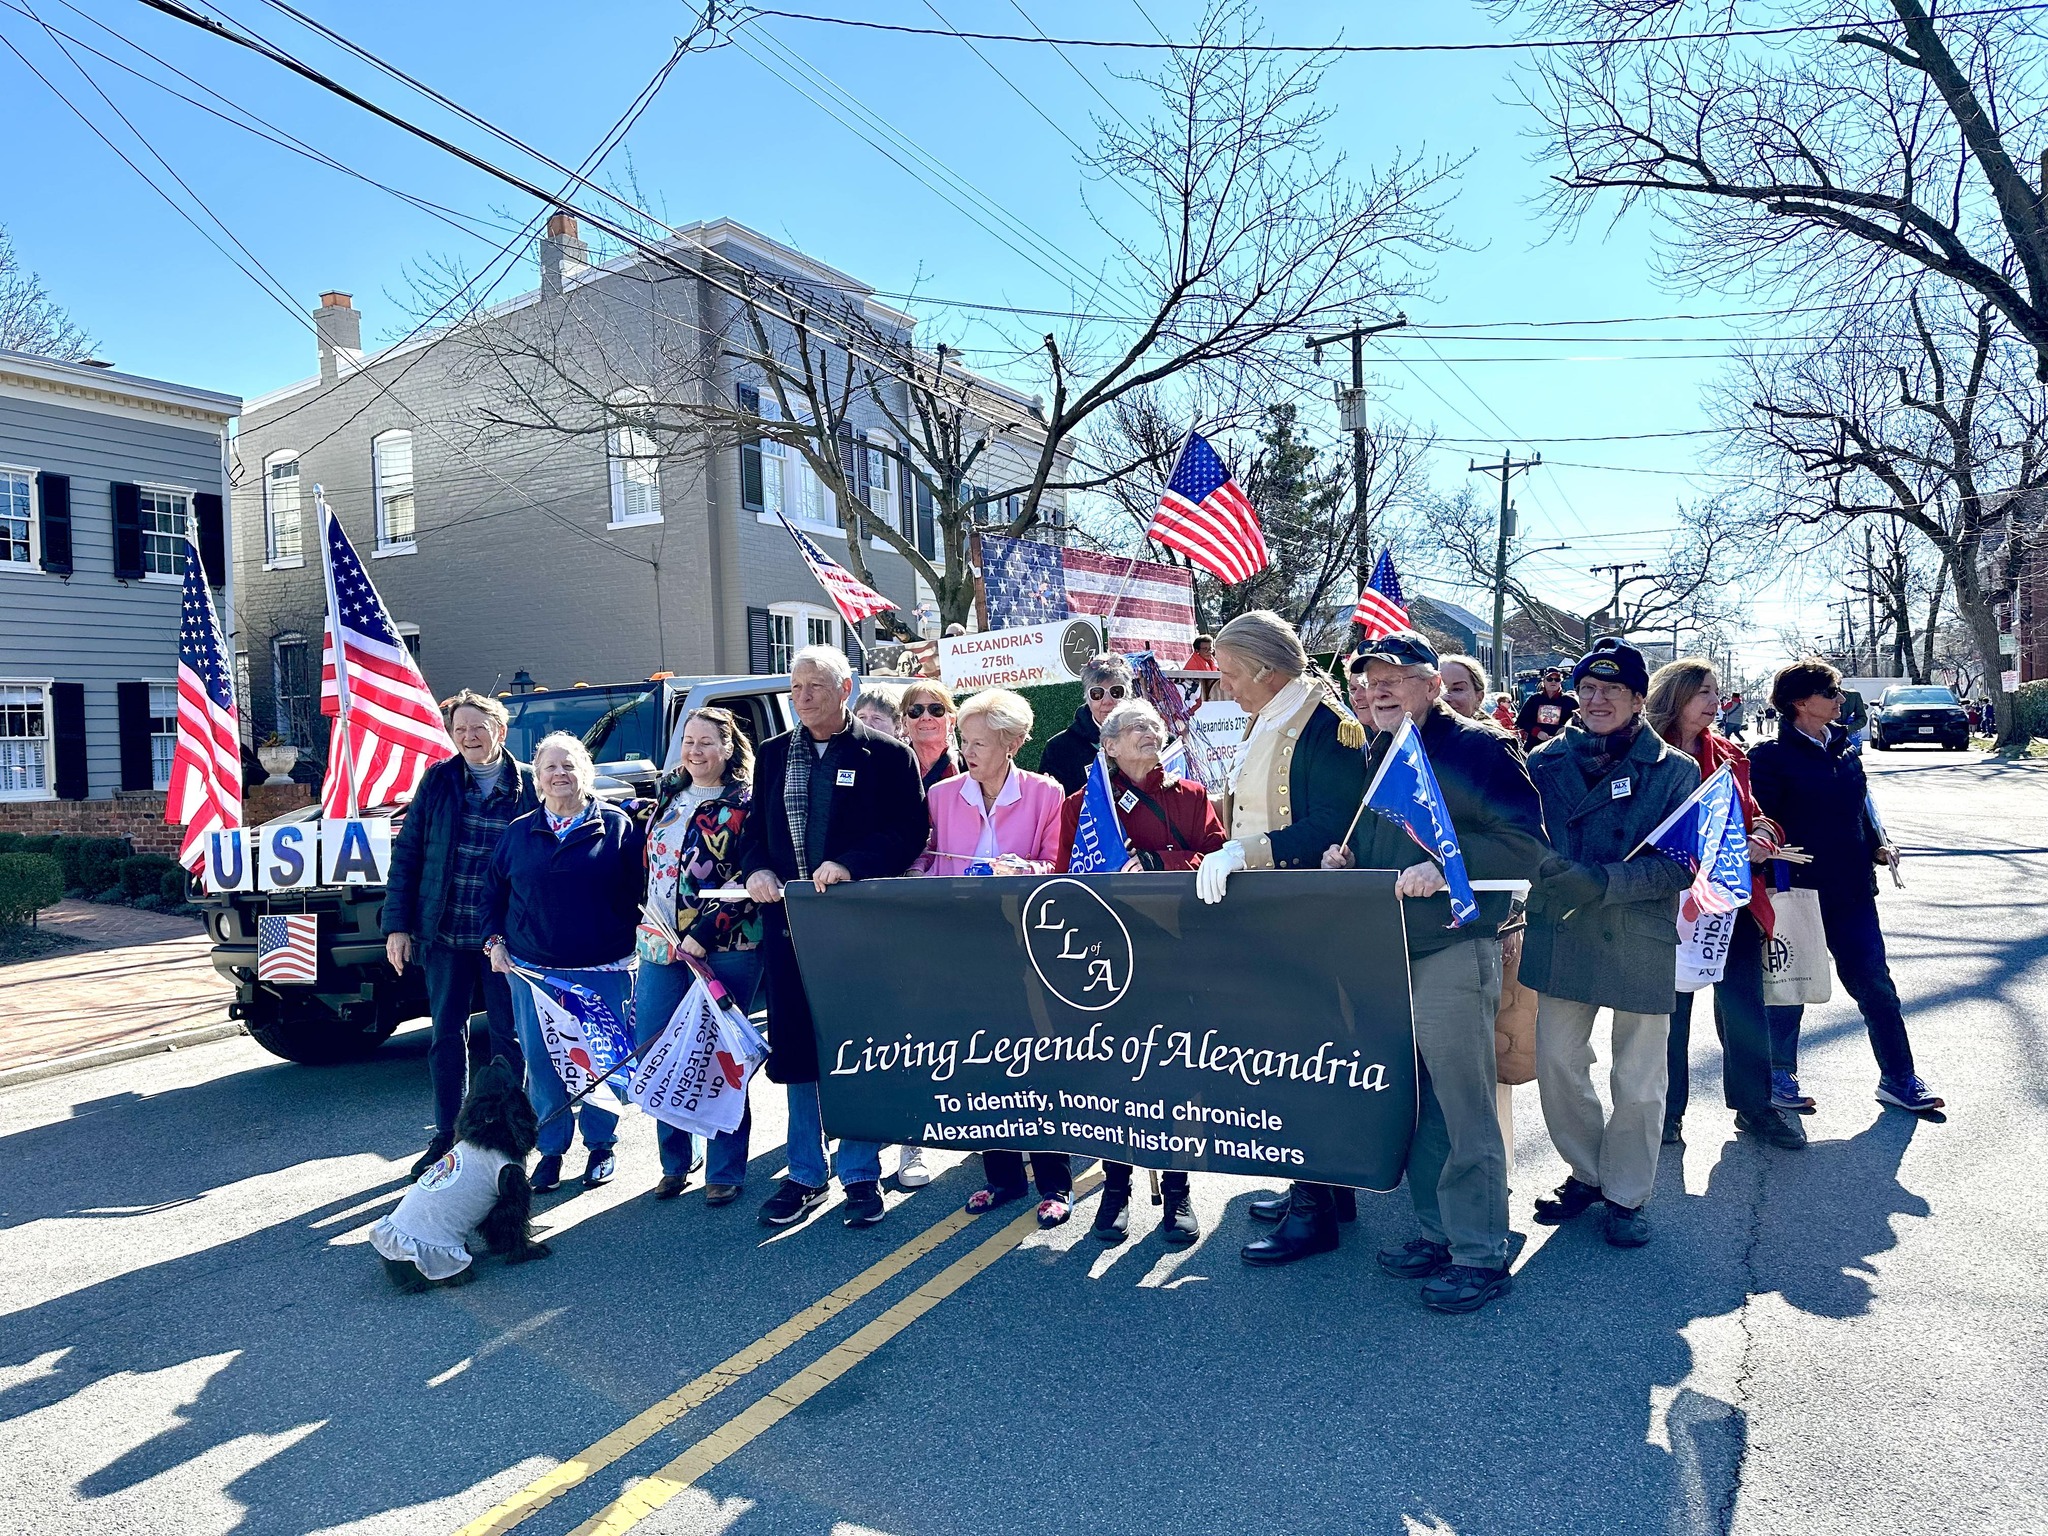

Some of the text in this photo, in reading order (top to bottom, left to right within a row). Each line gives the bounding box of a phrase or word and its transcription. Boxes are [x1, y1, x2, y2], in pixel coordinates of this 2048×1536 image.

[951, 632, 1043, 656] ALEXANDRIA'S
[956, 667, 1045, 689] ANNIVERSARY
[981, 654, 1014, 669] 275th
[1090, 941, 1102, 956] of
[829, 1022, 1390, 1092] Living Legends of Alexandria
[670, 1050, 703, 1107] LEGEND
[934, 1089, 1283, 1131] To identify, honor and chronicle
[1061, 1120, 1125, 1145] recent
[1128, 1127, 1207, 1157] history
[1214, 1138, 1305, 1165] makers
